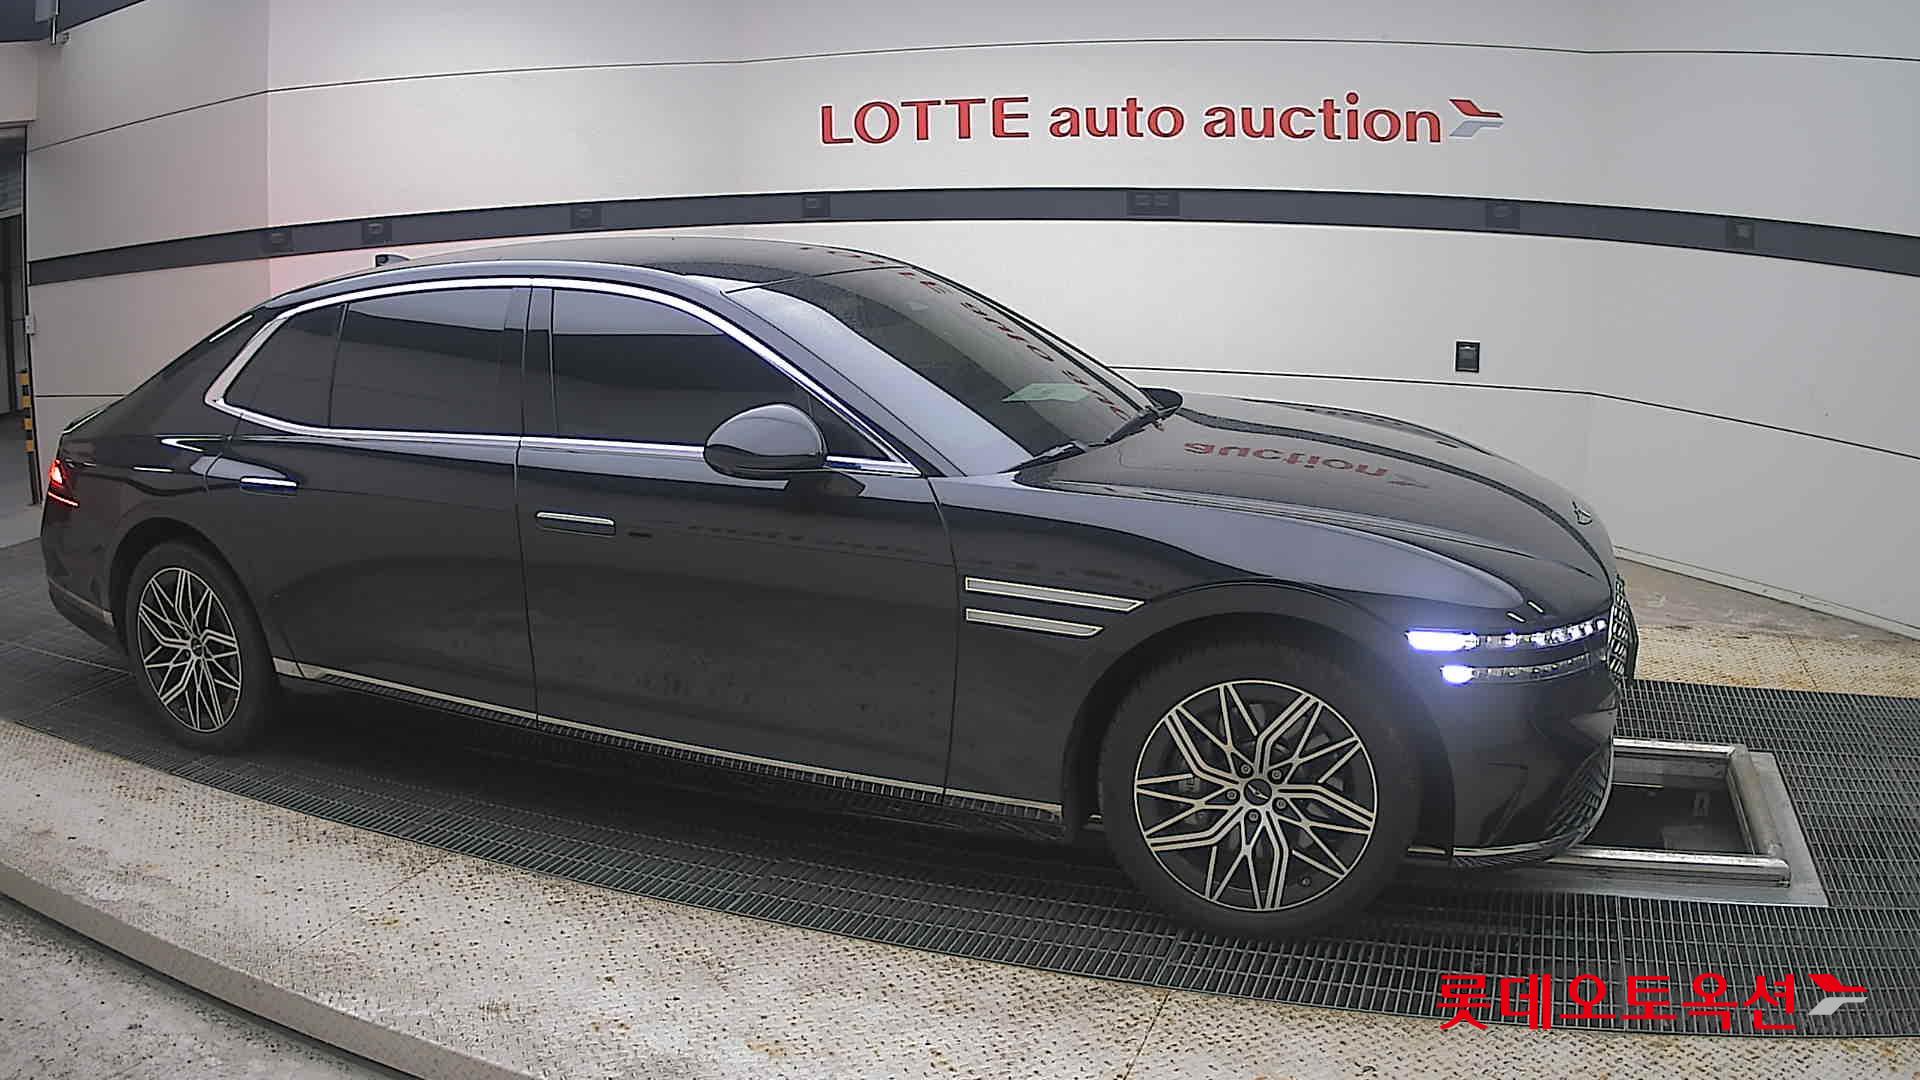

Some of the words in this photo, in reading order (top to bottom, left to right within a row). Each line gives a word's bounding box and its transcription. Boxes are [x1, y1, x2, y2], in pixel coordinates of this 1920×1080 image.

[820, 96, 1030, 145] LOTTE
[1048, 97, 1186, 139] auto
[1203, 92, 1442, 143] auction
